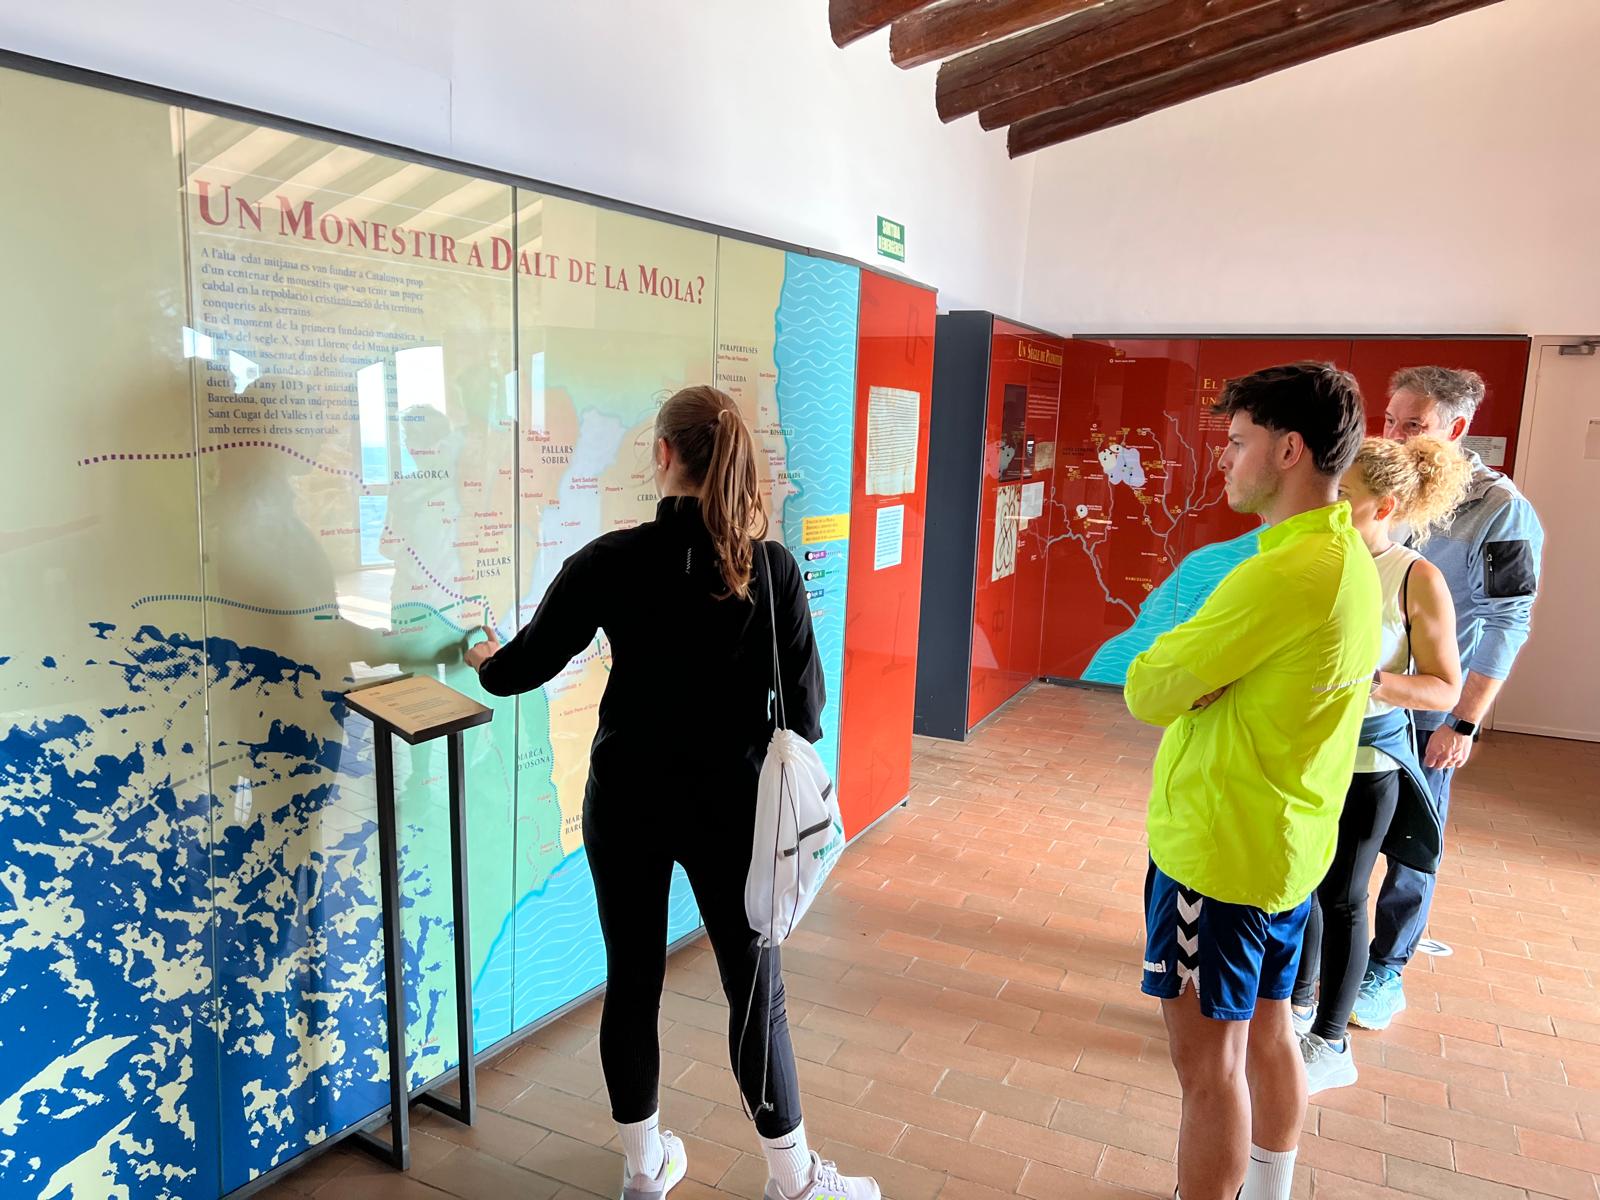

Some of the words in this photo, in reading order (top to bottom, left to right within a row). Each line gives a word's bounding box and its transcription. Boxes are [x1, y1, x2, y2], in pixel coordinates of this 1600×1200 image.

[201, 248, 209, 258] A
[212, 248, 237, 262] l'alta
[241, 252, 261, 264] edat
[264, 257, 298, 271] mitjana
[300, 263, 311, 271] es
[312, 265, 327, 274] van
[330, 264, 356, 278] fundar
[365, 270, 404, 284] Catalunya
[406, 277, 424, 289] prop
[466, 241, 485, 269] A
[568, 257, 598, 287] DE
[604, 265, 630, 292] LA
[201, 263, 224, 275] d'un
[227, 270, 269, 281] centenar
[273, 272, 285, 283] de
[287, 277, 330, 289] monestirs
[333, 282, 349, 292] que
[351, 284, 366, 293] van
[368, 285, 387, 296] tenir
[390, 289, 400, 297] un
[402, 291, 424, 303] paper
[202, 280, 234, 293] cabdal
[237, 286, 248, 294] en
[250, 285, 259, 295] la
[374, 300, 390, 310] dels
[391, 303, 424, 315] territoris
[202, 299, 256, 312] conquerits
[258, 302, 272, 313] als
[203, 313, 217, 324] En
[221, 314, 230, 324] el
[233, 316, 273, 329] moment
[276, 318, 287, 329] de
[290, 320, 298, 330] la
[301, 323, 336, 335] primera
[338, 324, 374, 337] fundació
[236, 331, 251, 341] del
[255, 334, 278, 346] segle
[294, 336, 314, 346] Sant
[317, 337, 348, 350] Llorenç
[352, 340, 365, 351] del
[260, 350, 297, 361] assentat
[299, 351, 317, 361] dins
[320, 352, 337, 364] dels
[273, 364, 311, 376] fundació
[313, 366, 353, 378] definitiva
[280, 380, 303, 390] 1013
[306, 384, 321, 393] per
[208, 392, 258, 405] Barcelona,
[260, 395, 278, 406] que
[280, 395, 288, 405] el
[290, 397, 305, 405] van
[208, 408, 230, 418] Sant
[233, 409, 261, 421] Cugat
[264, 409, 278, 419] del
[315, 411, 323, 421] el
[326, 413, 341, 421] van
[208, 423, 230, 434] amb
[233, 426, 261, 434] terres
[269, 424, 293, 435] drets
[541, 445, 574, 454] PALLARS
[476, 556, 511, 568] PALLARS
